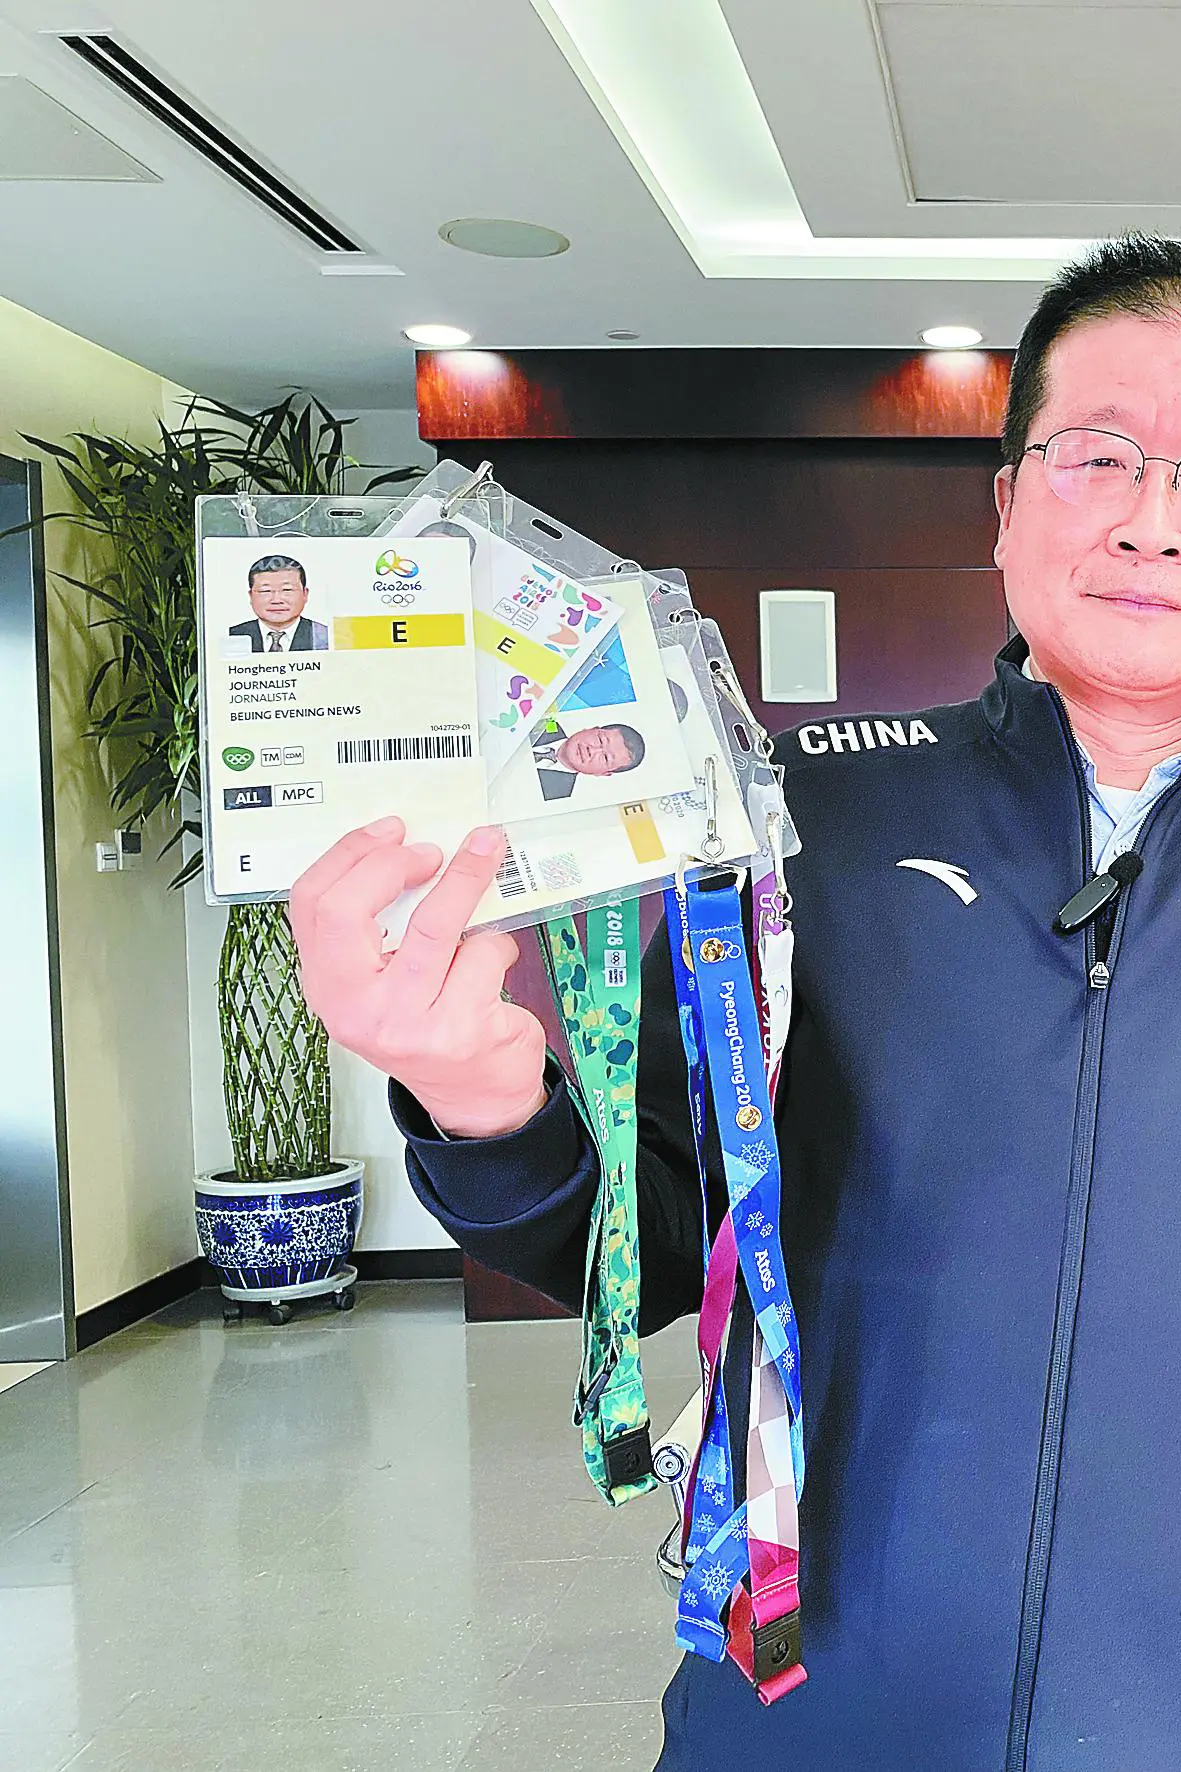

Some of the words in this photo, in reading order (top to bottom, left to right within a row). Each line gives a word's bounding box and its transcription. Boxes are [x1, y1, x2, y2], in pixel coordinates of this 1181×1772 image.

[373, 580, 422, 592] Rio2016
[392, 621, 408, 643] E
[496, 637, 516, 655] E
[228, 662, 287, 676] Hongheng
[289, 661, 322, 672] YUAN
[229, 679, 298, 691] JOURNALIST
[229, 692, 298, 704] JORNALISTA
[230, 710, 273, 722] BEIJING
[274, 706, 325, 720] EVENING
[327, 705, 362, 717] NEWS
[430, 723, 472, 733] 1042729-01
[798, 719, 939, 755] CHINA
[263, 753, 281, 763] TM
[235, 791, 263, 805] ALL
[282, 787, 316, 801] MPC
[624, 803, 644, 816] E
[240, 855, 252, 872] E
[606, 910, 624, 946] 2018
[721, 980, 746, 1085] PyeongChang
[754, 1248, 776, 1292] Atos
